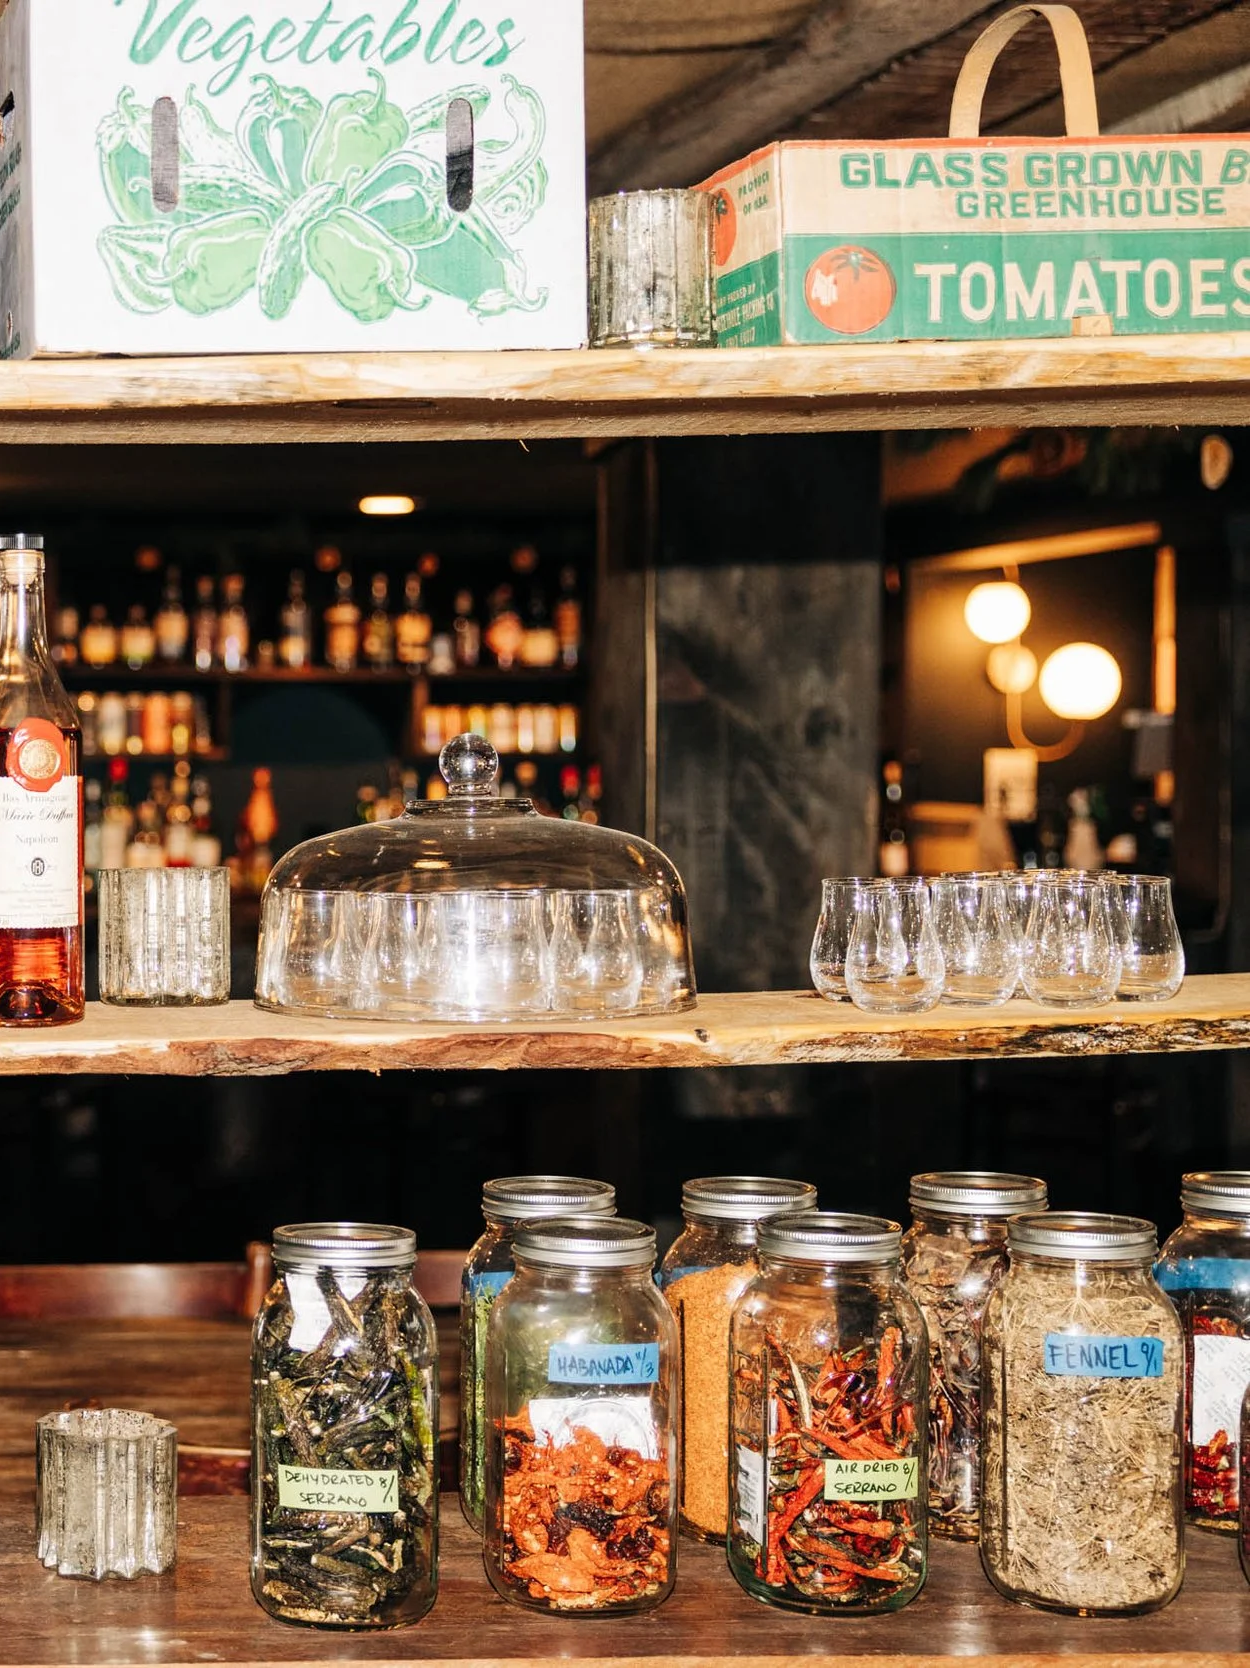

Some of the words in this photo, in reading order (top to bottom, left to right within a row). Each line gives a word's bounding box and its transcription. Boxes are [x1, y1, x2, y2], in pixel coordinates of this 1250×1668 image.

[114, 0, 527, 96] Vegetables
[839, 152, 1009, 189] GLASS
[1023, 149, 1203, 189] GROWN
[955, 187, 1227, 220] GREENHOUSE
[914, 257, 1250, 324] TOMATOES
[557, 1355, 634, 1377] HABANADA
[1048, 1343, 1138, 1370] FENNEL
[285, 1470, 374, 1487] DEHYDRATED
[835, 1462, 857, 1474] AIR
[864, 1462, 899, 1473] DRIED
[834, 1482, 897, 1494] SERRANO
